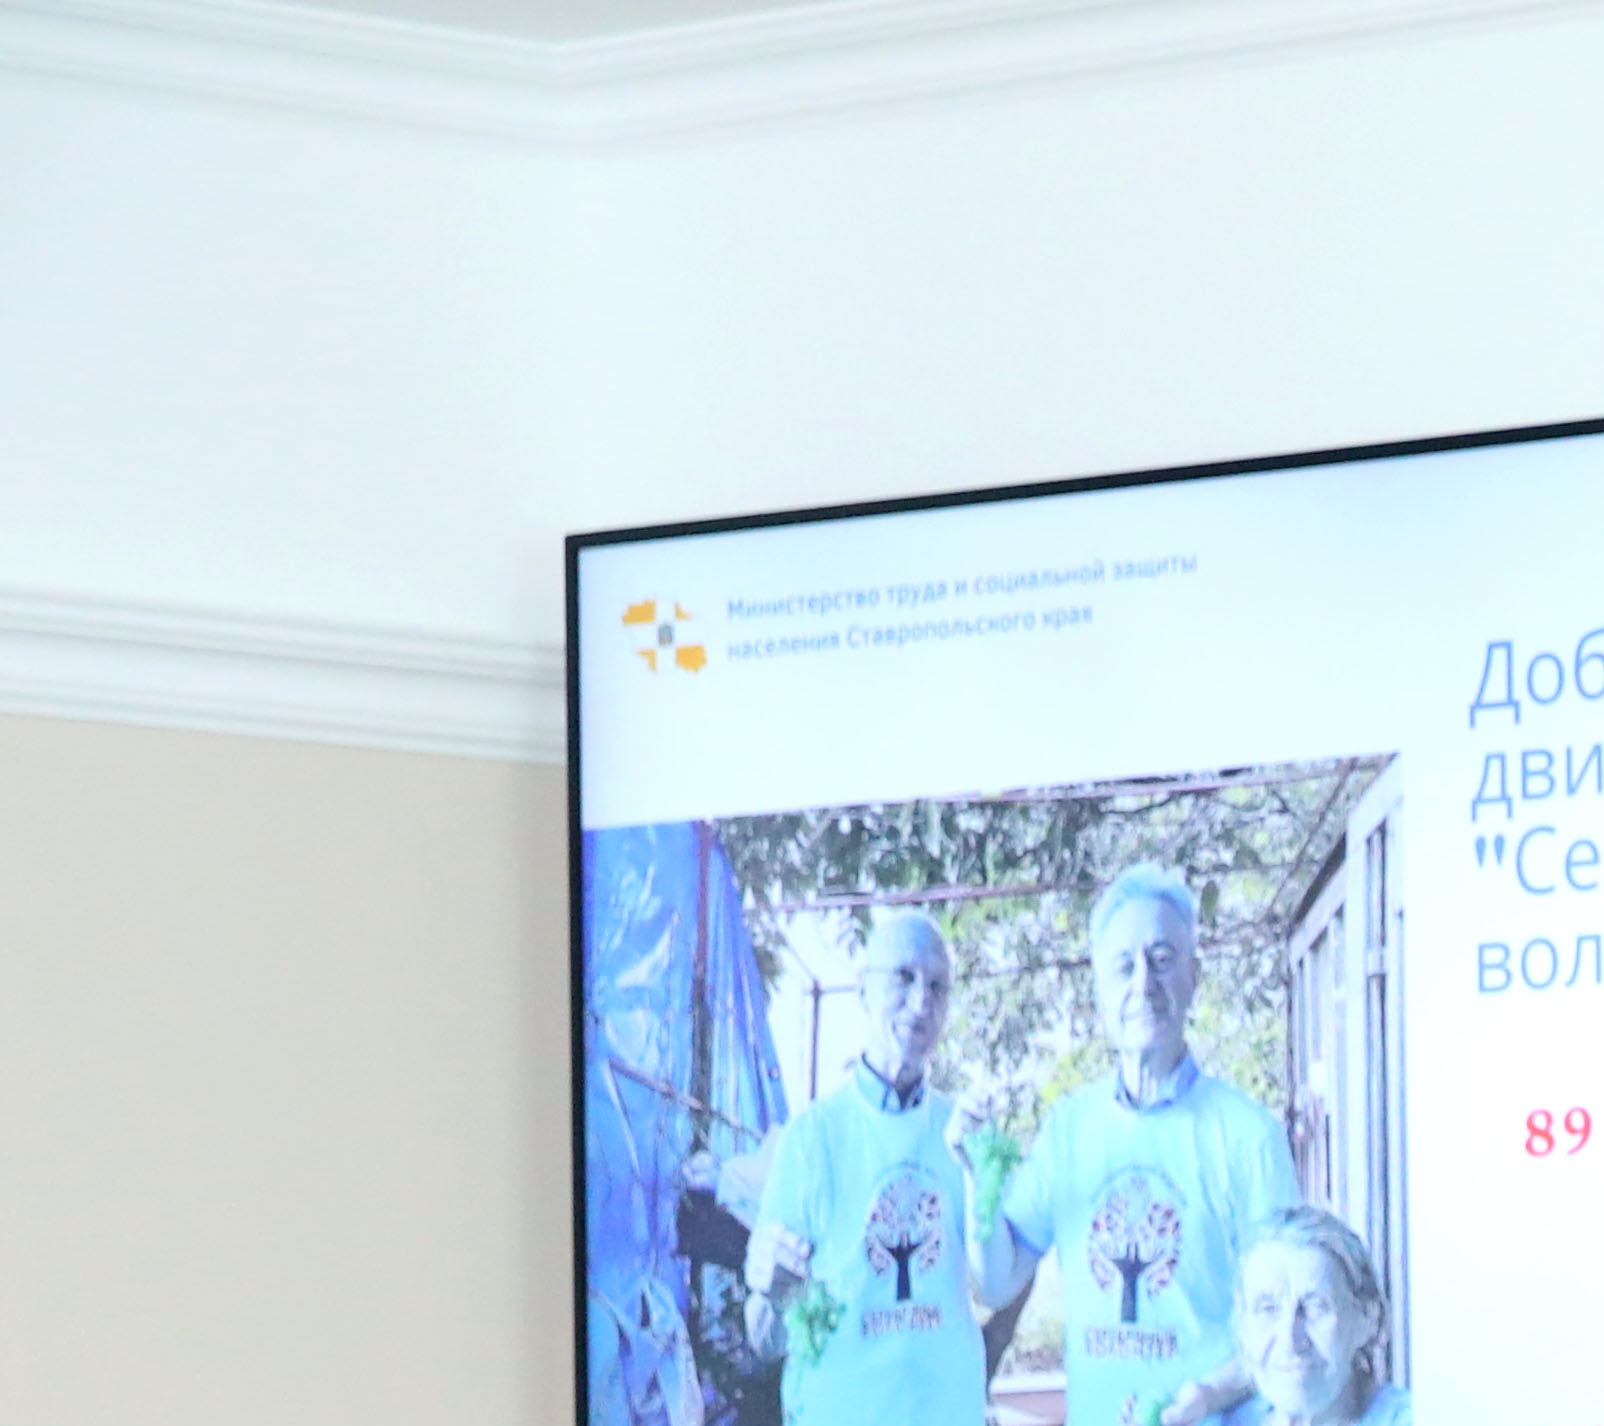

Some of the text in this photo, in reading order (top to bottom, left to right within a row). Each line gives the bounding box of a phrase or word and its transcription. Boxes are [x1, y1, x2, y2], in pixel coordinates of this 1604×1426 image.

[727, 554, 1197, 623] Министерство труда и социальной защиты
[727, 605, 1093, 661] населения Ставропольского края
[1524, 1106, 1593, 1158] 89
